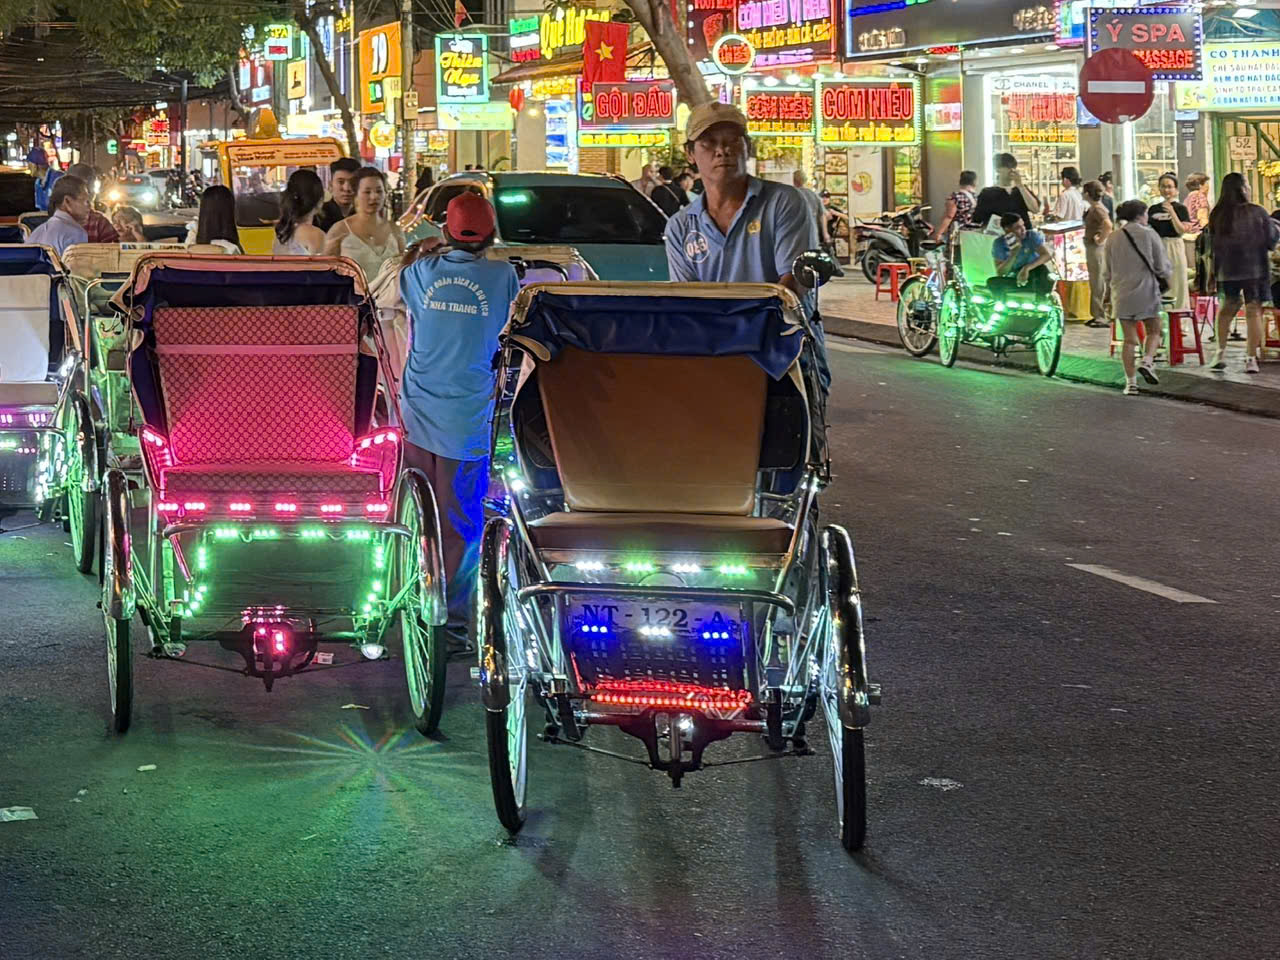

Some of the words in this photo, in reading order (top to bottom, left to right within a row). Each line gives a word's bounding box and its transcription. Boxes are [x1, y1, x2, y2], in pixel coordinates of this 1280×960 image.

[1106, 19, 1123, 43] Ý
[1131, 23, 1186, 43] SPA
[1232, 48, 1280, 59] THANH
[1013, 80, 1049, 89] CHANEL
[596, 87, 628, 123] GỘI
[1235, 136, 1252, 149] 52
[447, 302, 479, 315] TRANG
